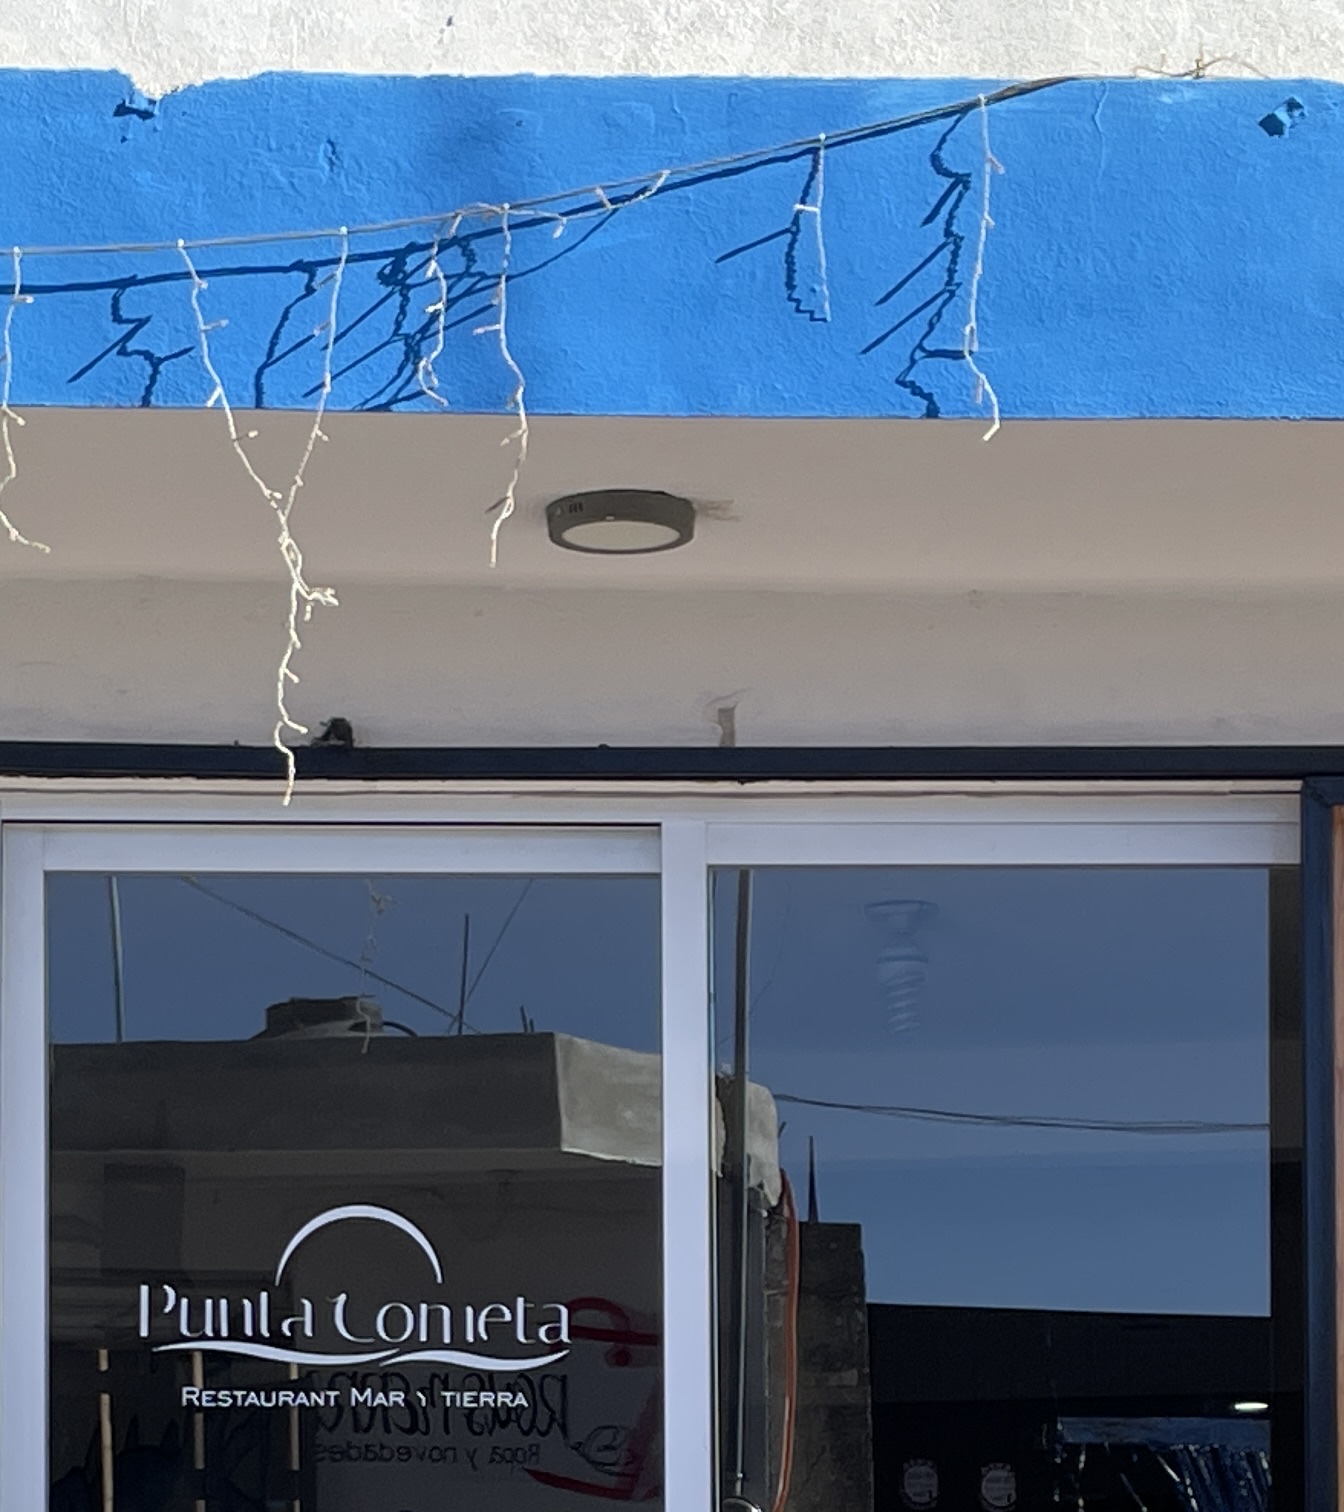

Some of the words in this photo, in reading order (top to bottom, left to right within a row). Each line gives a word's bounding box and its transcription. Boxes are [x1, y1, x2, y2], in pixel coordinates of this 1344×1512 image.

[139, 1284, 314, 1339] Punta
[325, 1292, 572, 1345] Cometa
[181, 1386, 340, 1408] RESTAURANT
[350, 1387, 405, 1408] MAR
[440, 1390, 529, 1409] TIERRA
